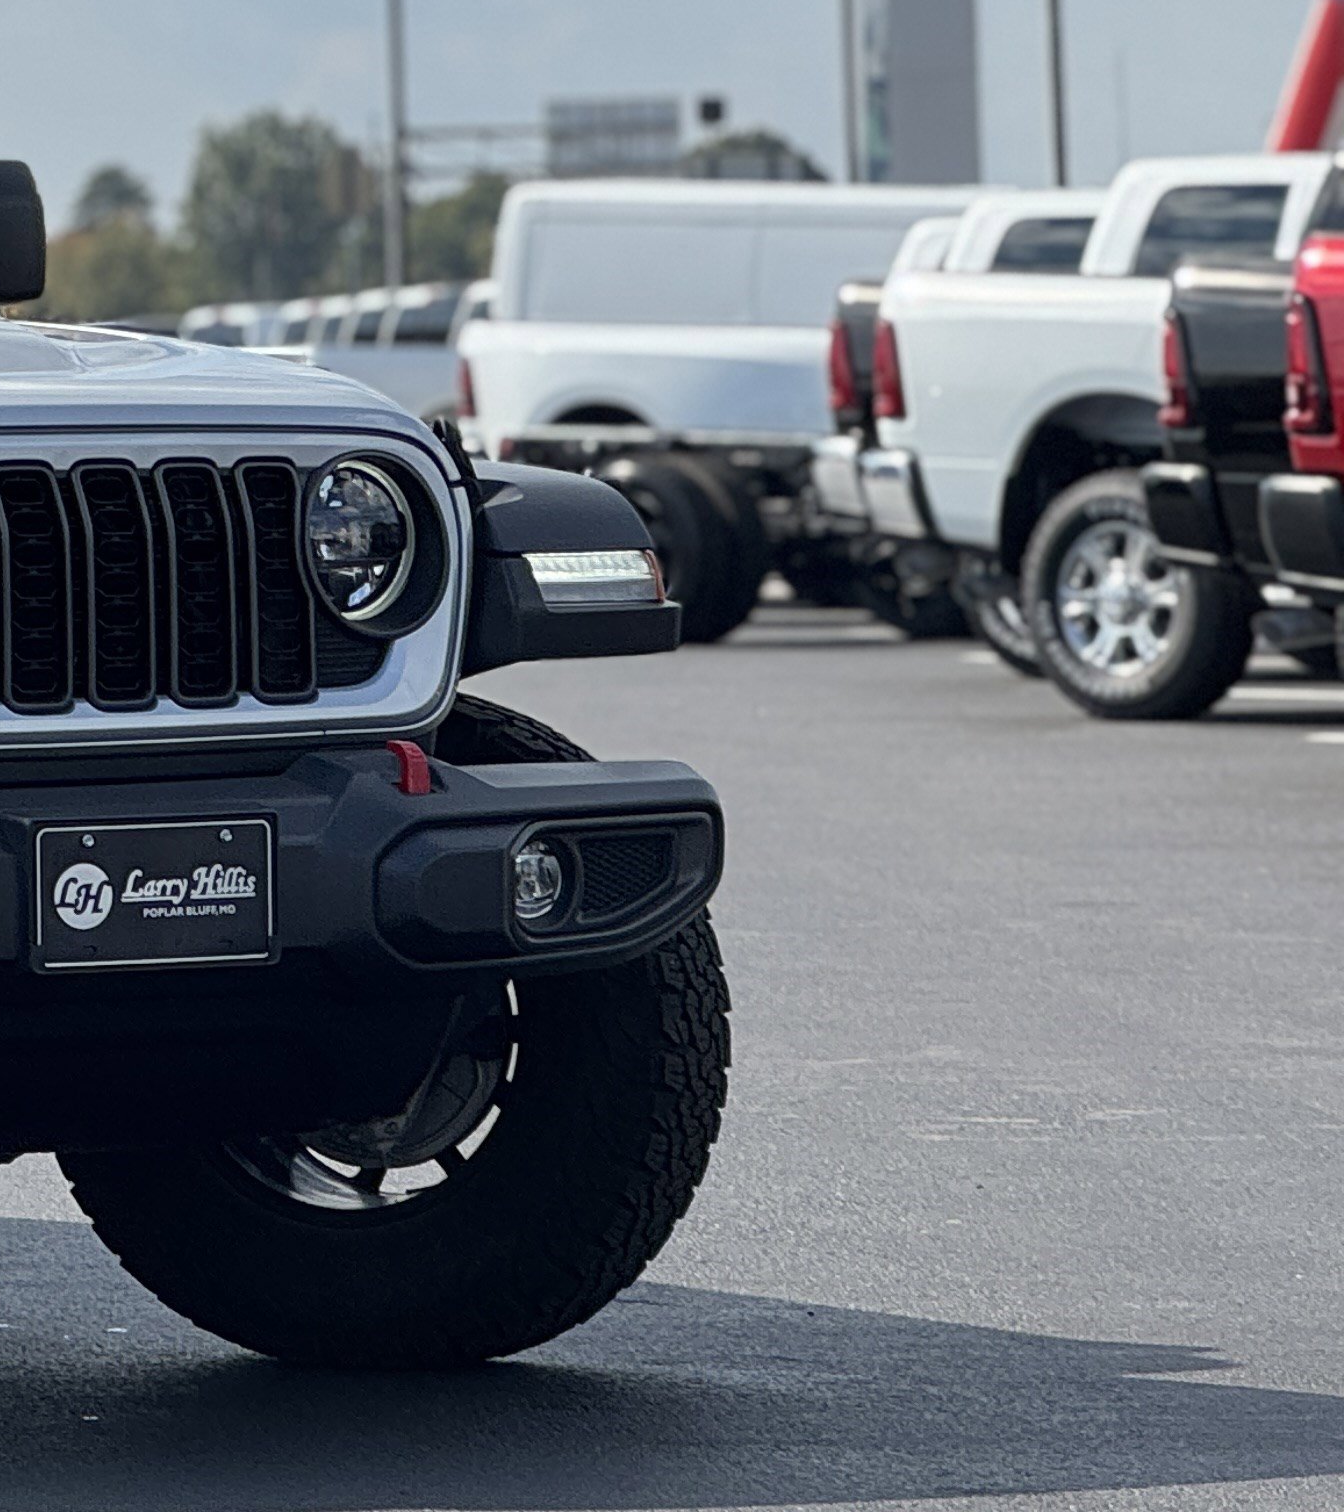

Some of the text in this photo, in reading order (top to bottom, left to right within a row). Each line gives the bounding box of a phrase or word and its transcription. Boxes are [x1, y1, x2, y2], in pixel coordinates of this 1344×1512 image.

[121, 863, 257, 904] Larry Hillis
[143, 905, 184, 919] POPLAR
